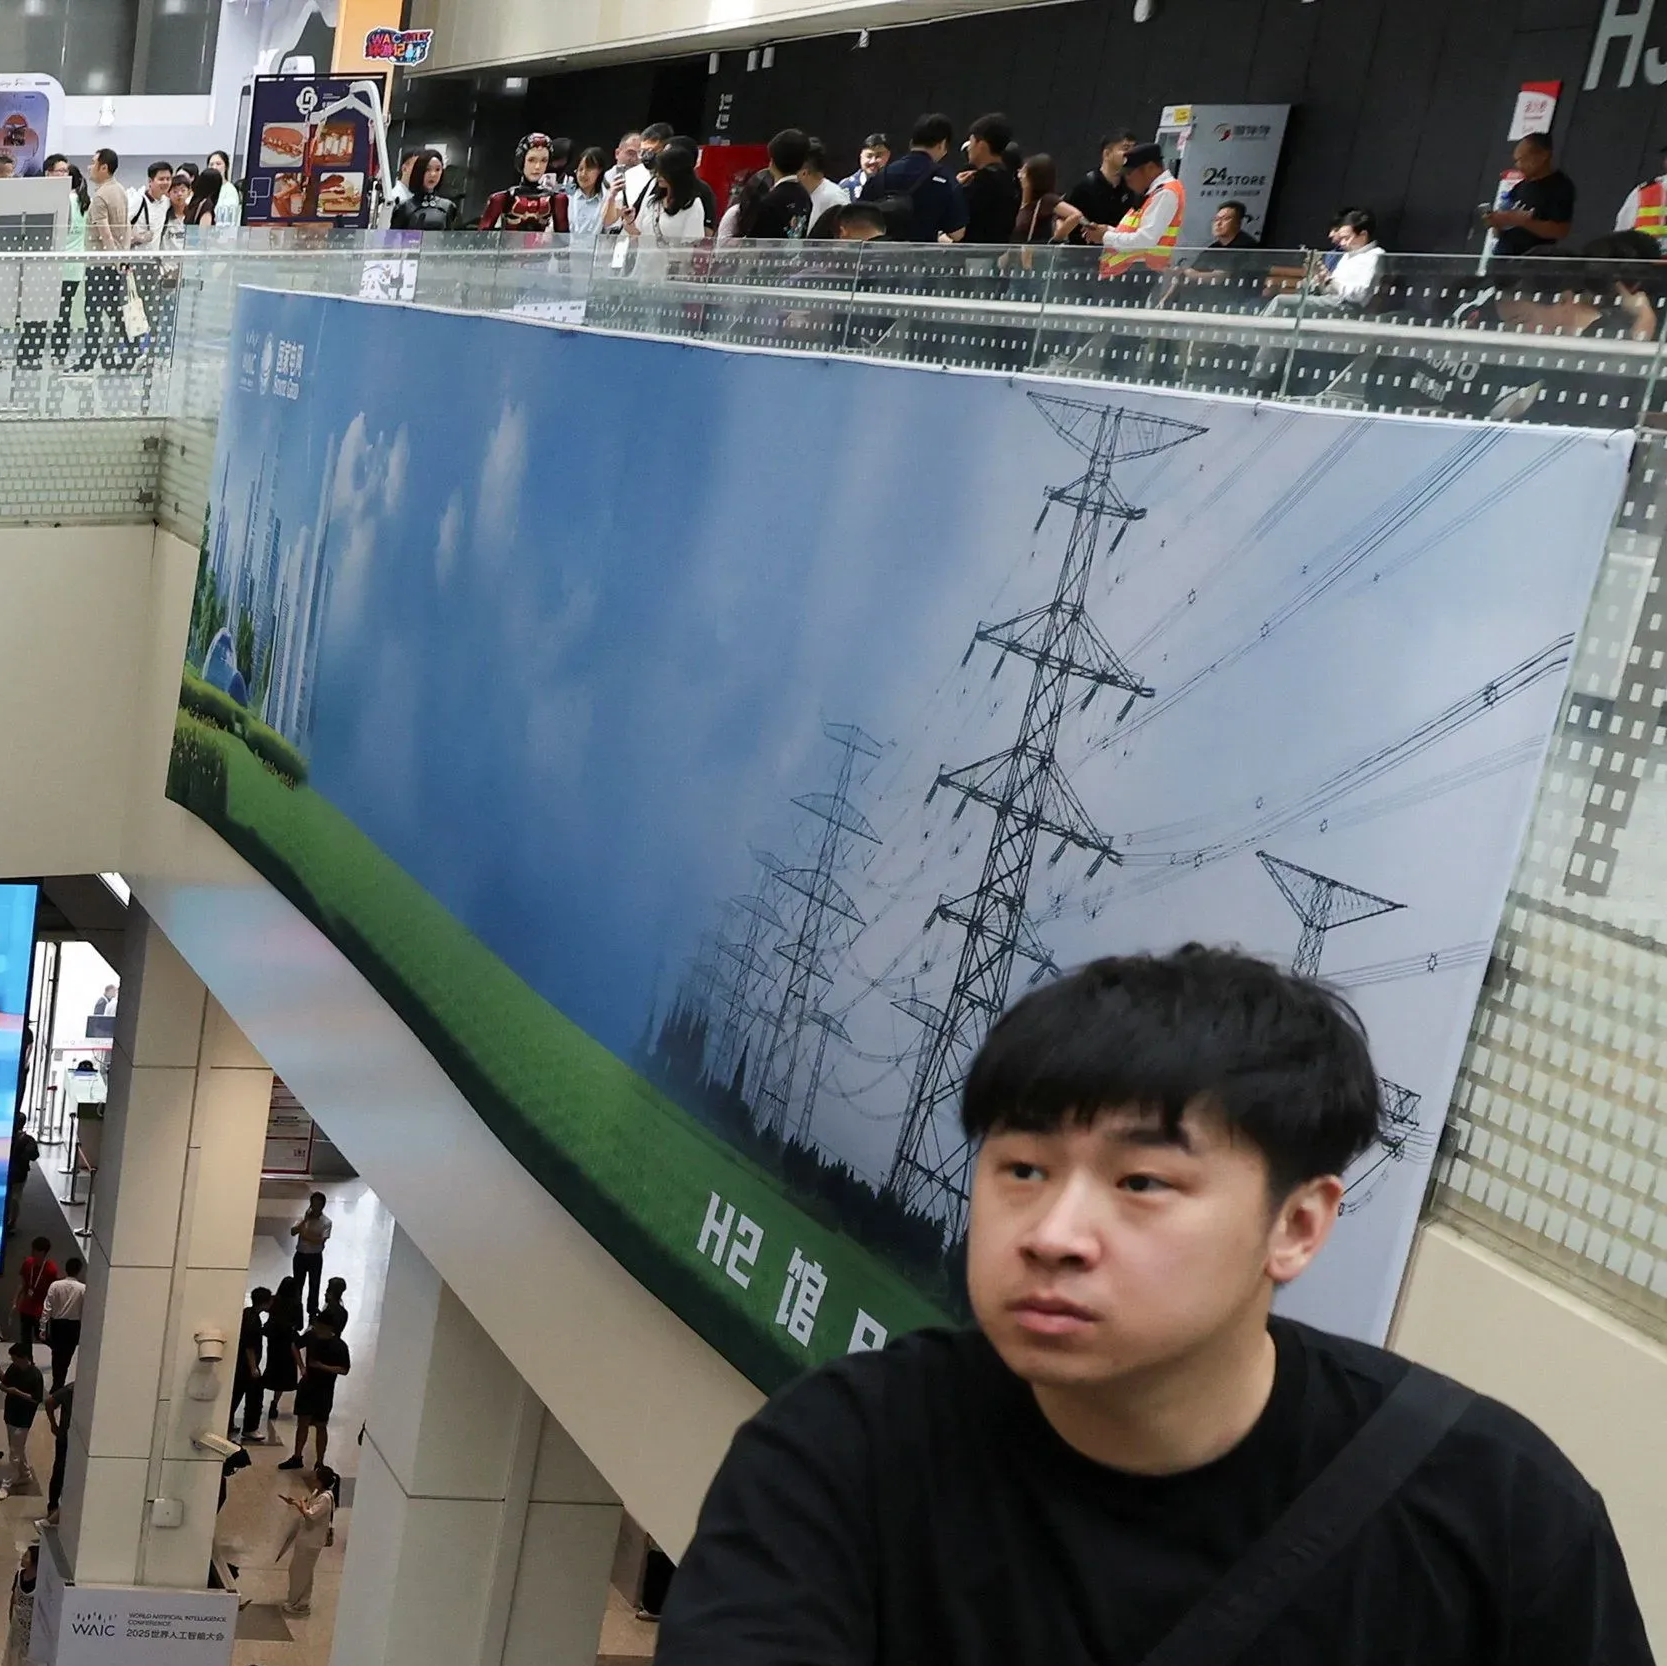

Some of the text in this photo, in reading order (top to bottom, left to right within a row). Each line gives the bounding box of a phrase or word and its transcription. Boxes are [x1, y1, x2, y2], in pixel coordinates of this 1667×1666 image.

[695, 1190, 765, 1290] H2
[775, 1247, 827, 1346] 馆
[71, 1623, 115, 1638] WAIC
[125, 1628, 225, 1642] 2025世界人工智能大会
